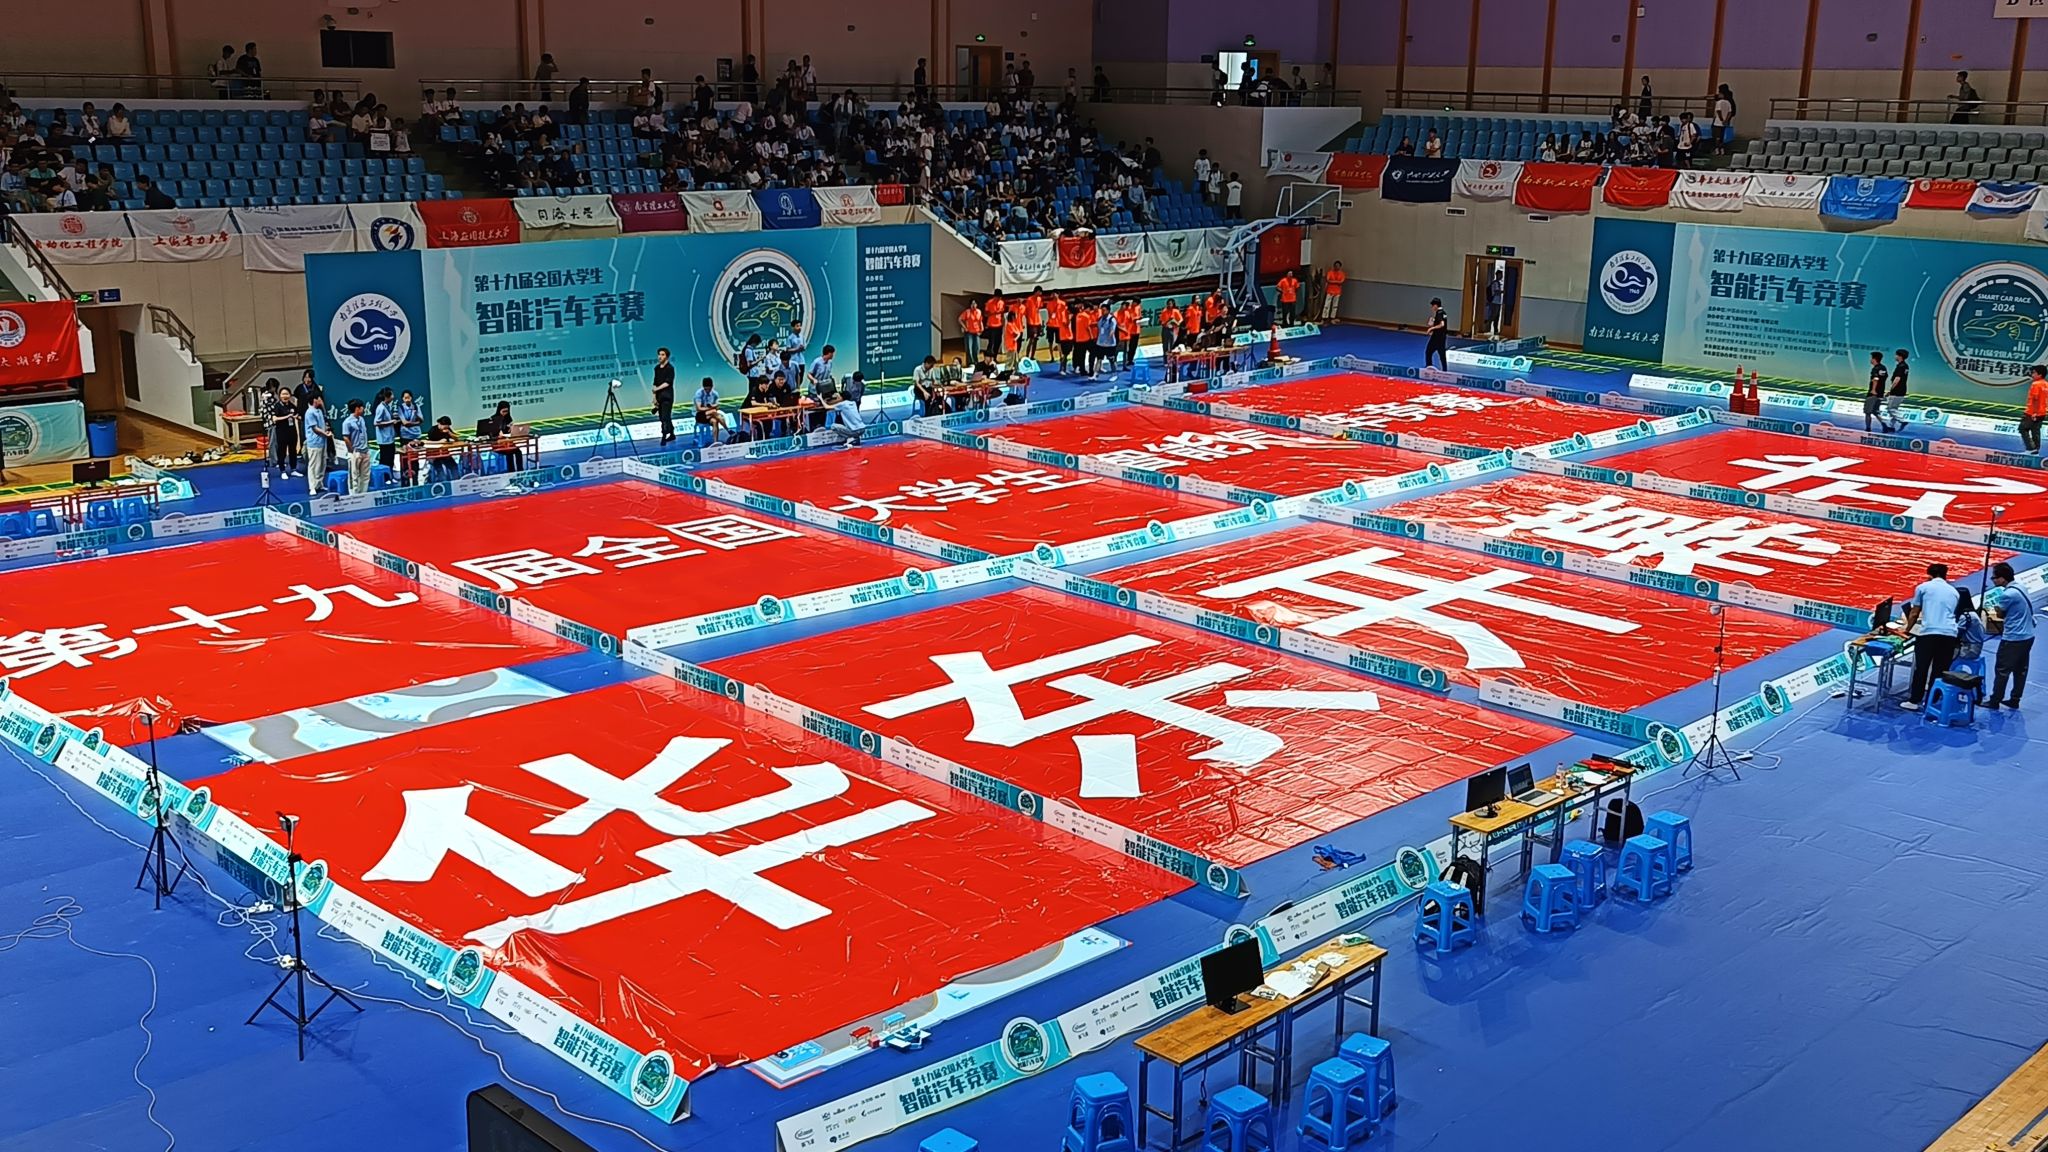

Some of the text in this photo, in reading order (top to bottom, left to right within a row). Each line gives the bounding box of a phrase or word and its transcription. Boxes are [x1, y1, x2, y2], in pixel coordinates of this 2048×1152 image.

[537, 207, 594, 220] 同济大学
[865, 254, 920, 271] 智能汽车竞赛
[1713, 249, 1829, 272] 第十九届全国大学生
[474, 268, 604, 292] 第十九届全国大学生
[1709, 270, 1868, 310] 智能汽车竞赛
[755, 292, 773, 301] 2024
[1992, 303, 2015, 312] 2024
[476, 290, 645, 336] 智能汽车竞赛
[373, 343, 388, 351] 1960
[0, 583, 419, 680] 第十九
[450, 513, 806, 592] 届全国
[829, 469, 1104, 522] 大学生
[360, 734, 938, 948] 华
[860, 632, 1381, 800] 东
[1196, 547, 1641, 671] 开
[1150, 973, 1204, 1010] 智能汽车
[553, 1026, 627, 1084] 智能汽车竞赛
[899, 1060, 999, 1115] 智能汽车竞赛
